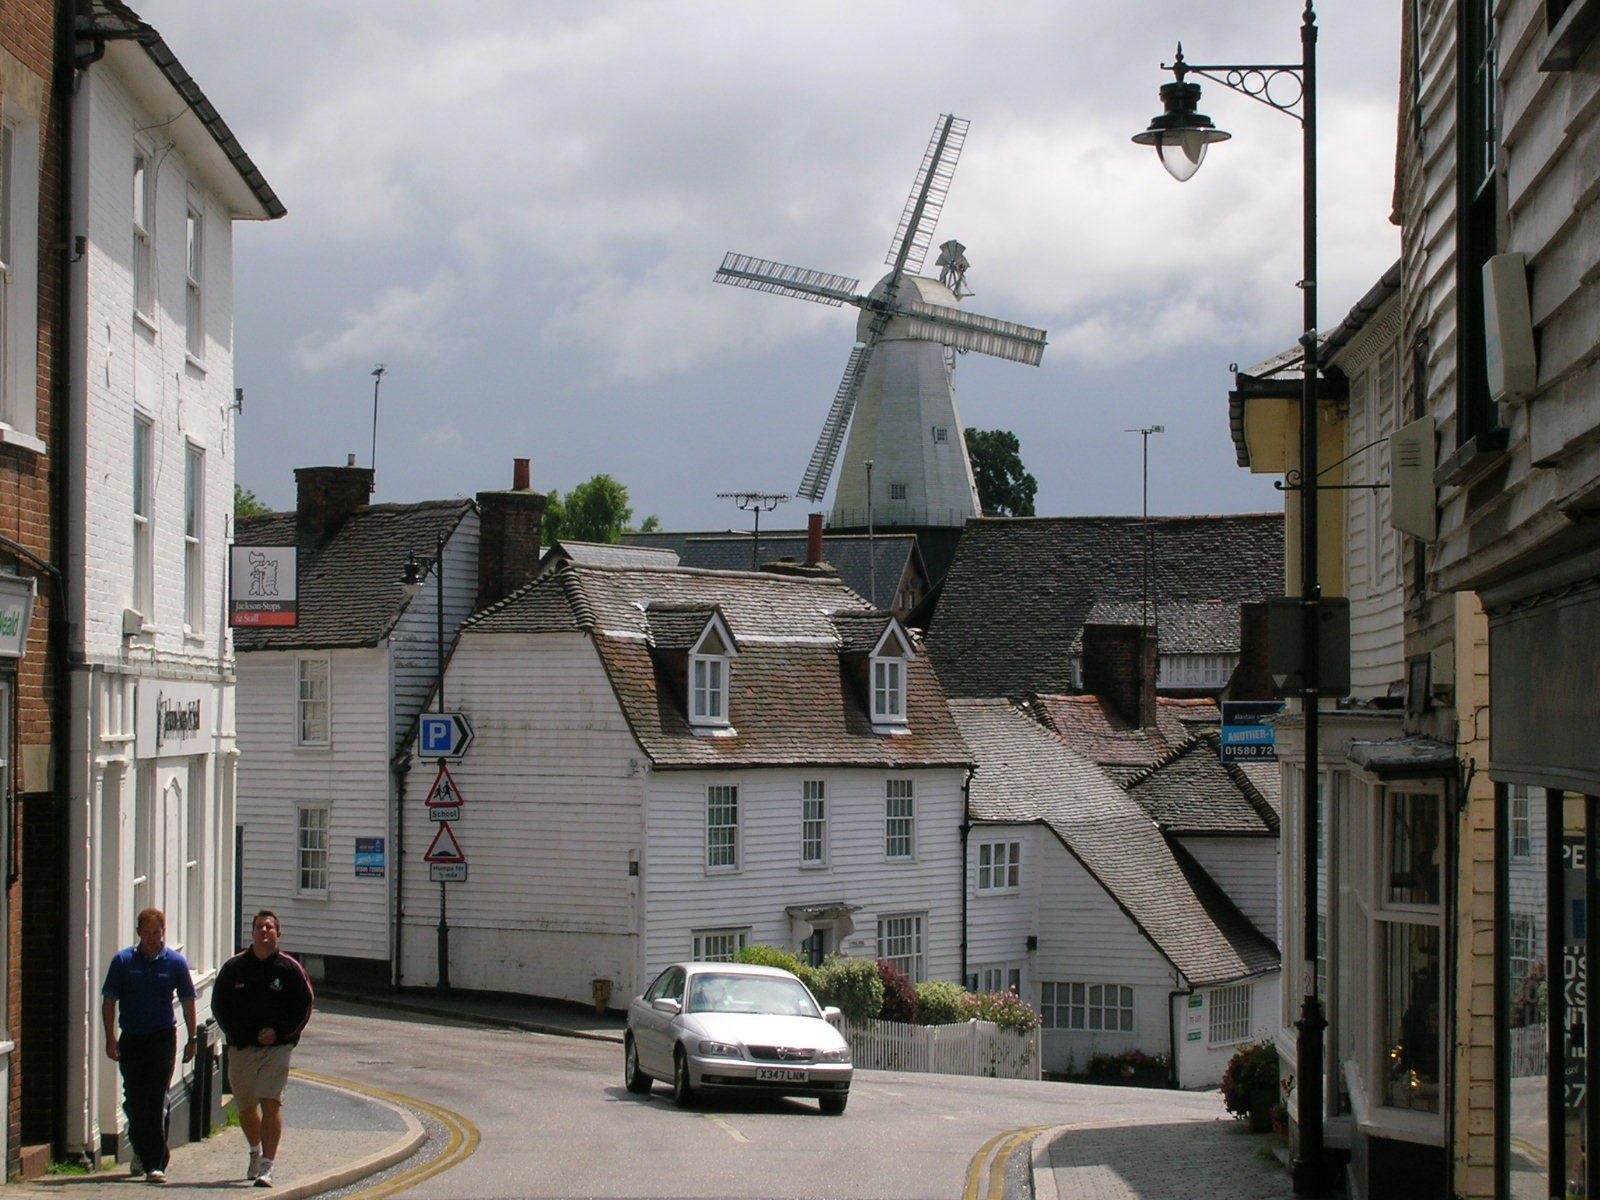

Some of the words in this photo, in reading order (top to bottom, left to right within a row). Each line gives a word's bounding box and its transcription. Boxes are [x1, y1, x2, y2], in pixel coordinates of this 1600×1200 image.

[235, 601, 281, 612] Jackson-Stops
[429, 722, 447, 748] P
[1225, 746, 1257, 755] 01580
[432, 810, 457, 819] School
[760, 1069, 785, 1079] X347
